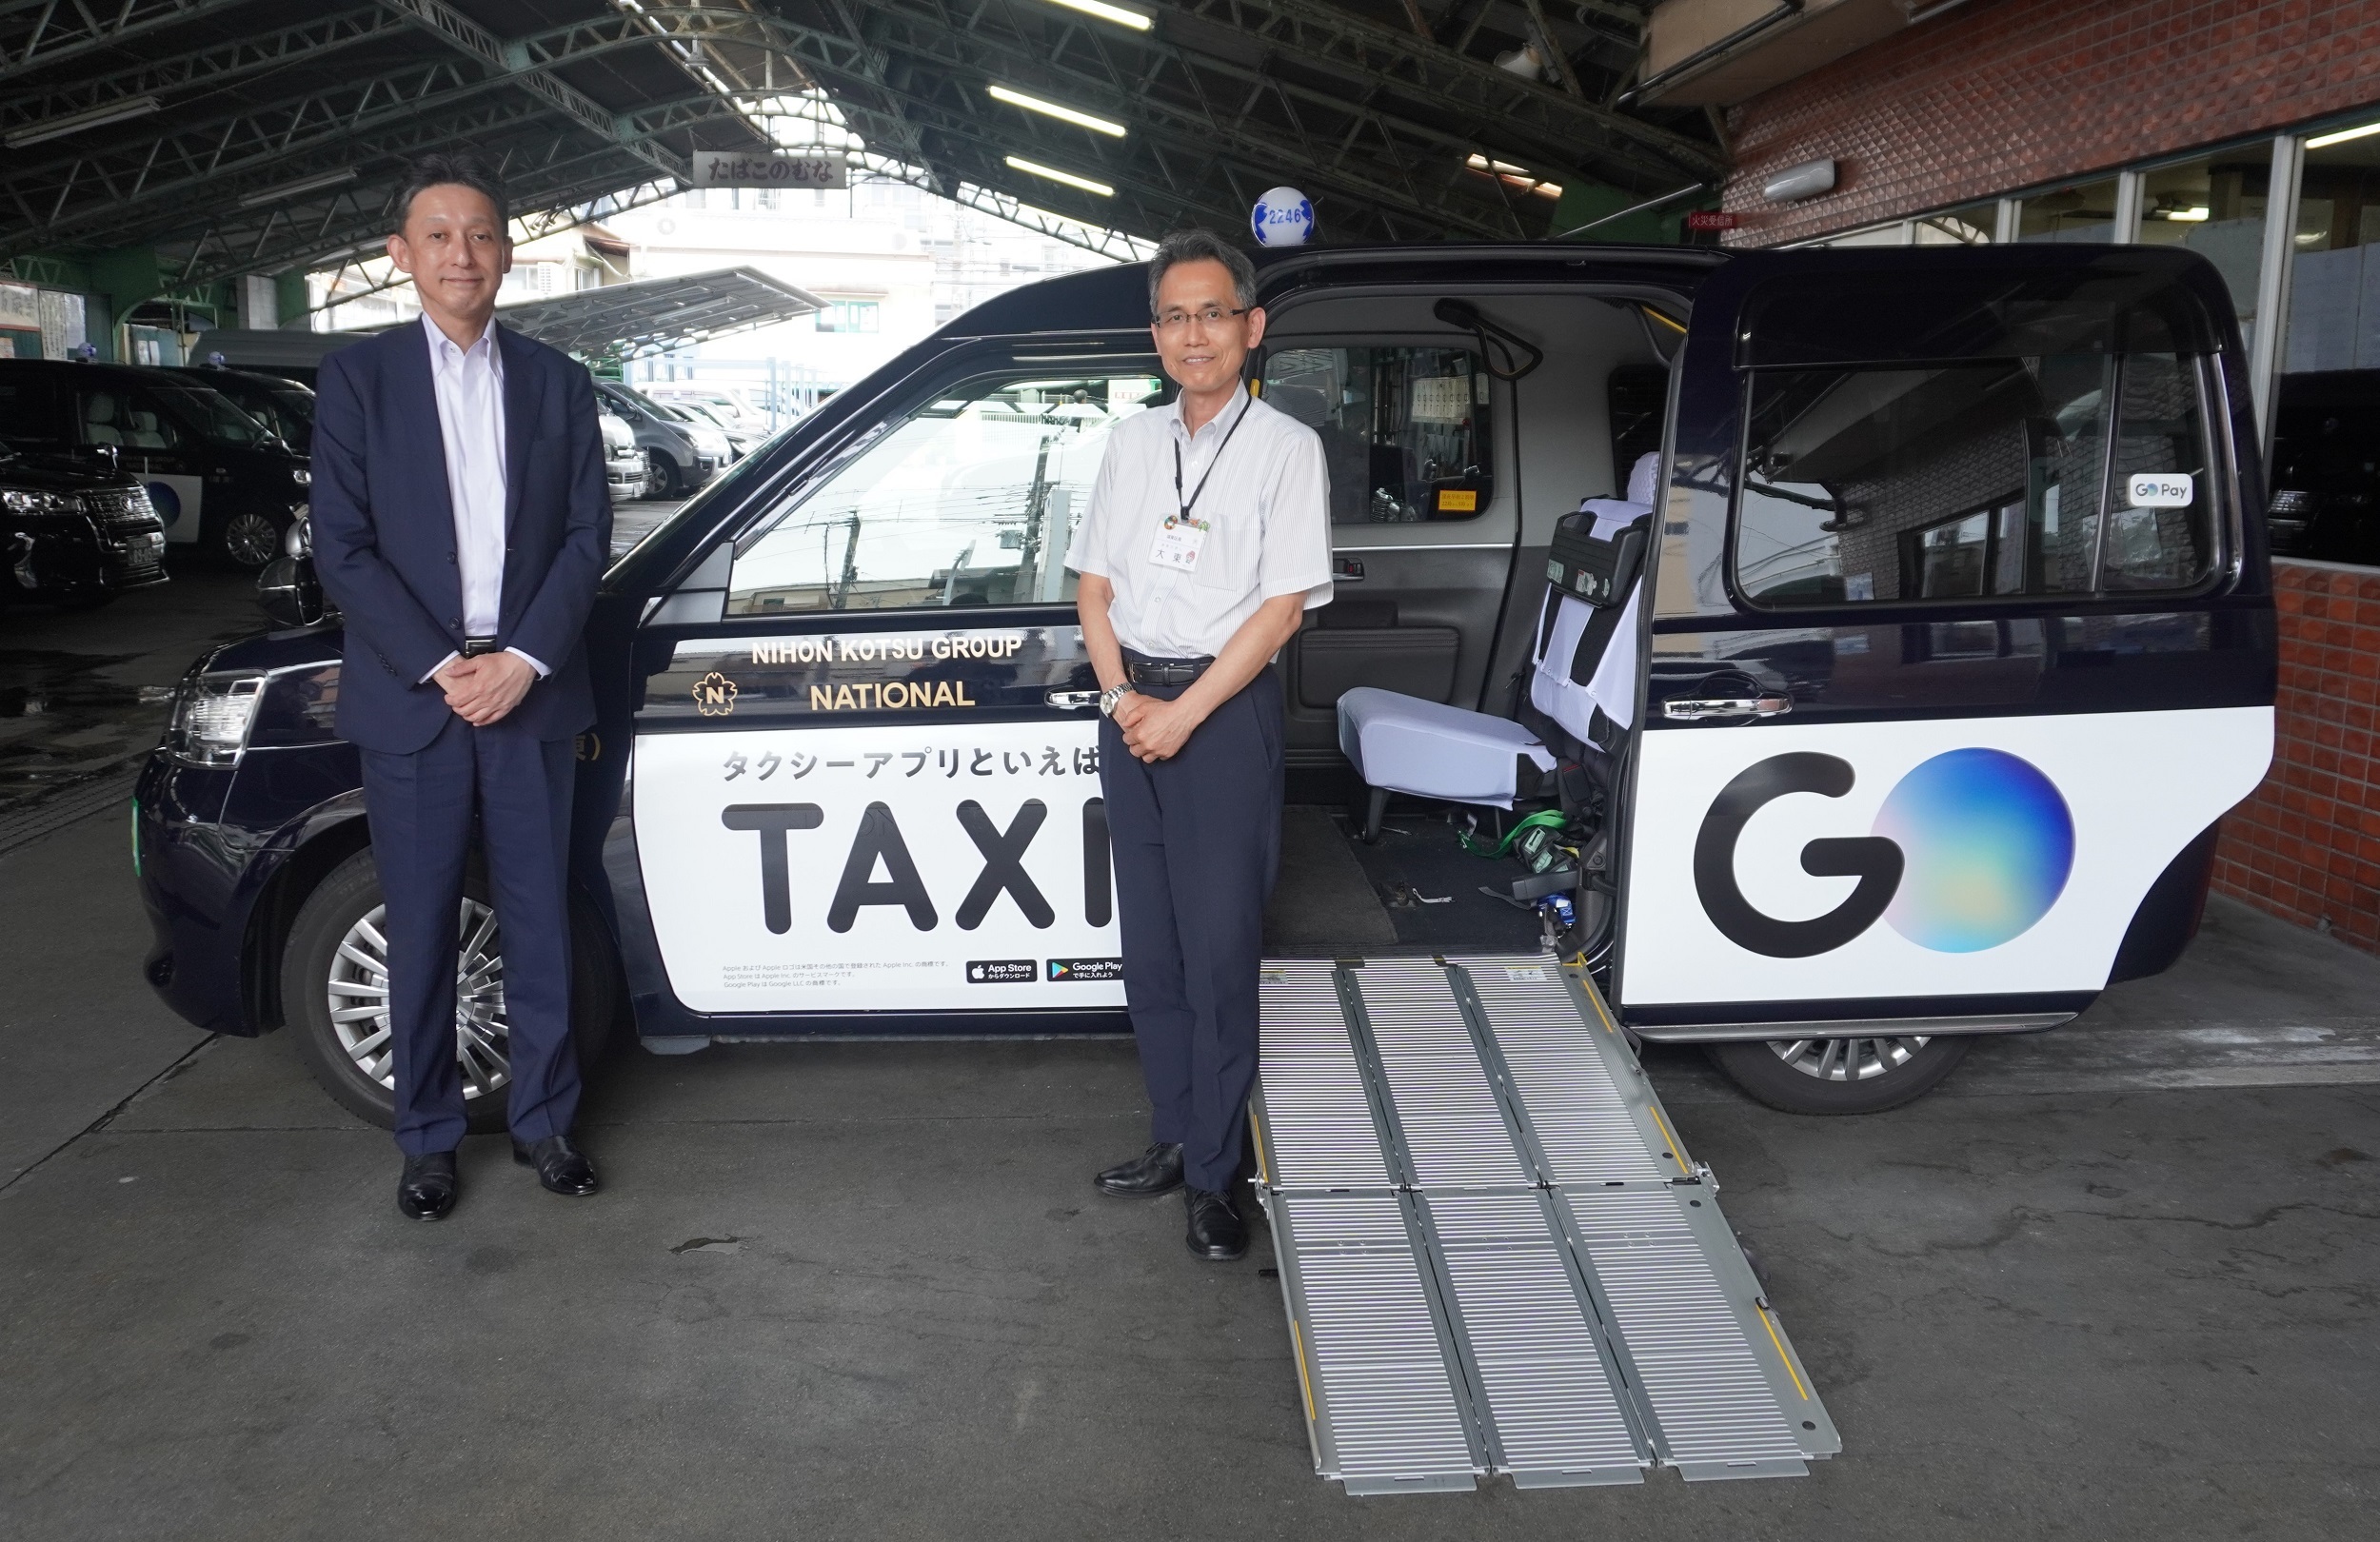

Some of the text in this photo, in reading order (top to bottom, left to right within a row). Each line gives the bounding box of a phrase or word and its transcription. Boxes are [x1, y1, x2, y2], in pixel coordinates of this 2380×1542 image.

[708, 157, 834, 183] たばこのむな
[1269, 208, 1301, 225] 2246
[1692, 214, 1733, 227] 火災受信所
[2135, 483, 2188, 500] GO Pay
[751, 635, 1022, 664] NIHON KOTSU GROUP
[810, 681, 976, 711] NATIONAL
[723, 745, 1100, 782] タクシーアプリといえば
[1693, 746, 2077, 959] GO
[721, 797, 1113, 935] TAXI
[988, 963, 1032, 973] App Store
[1072, 961, 1122, 972] Google Play
